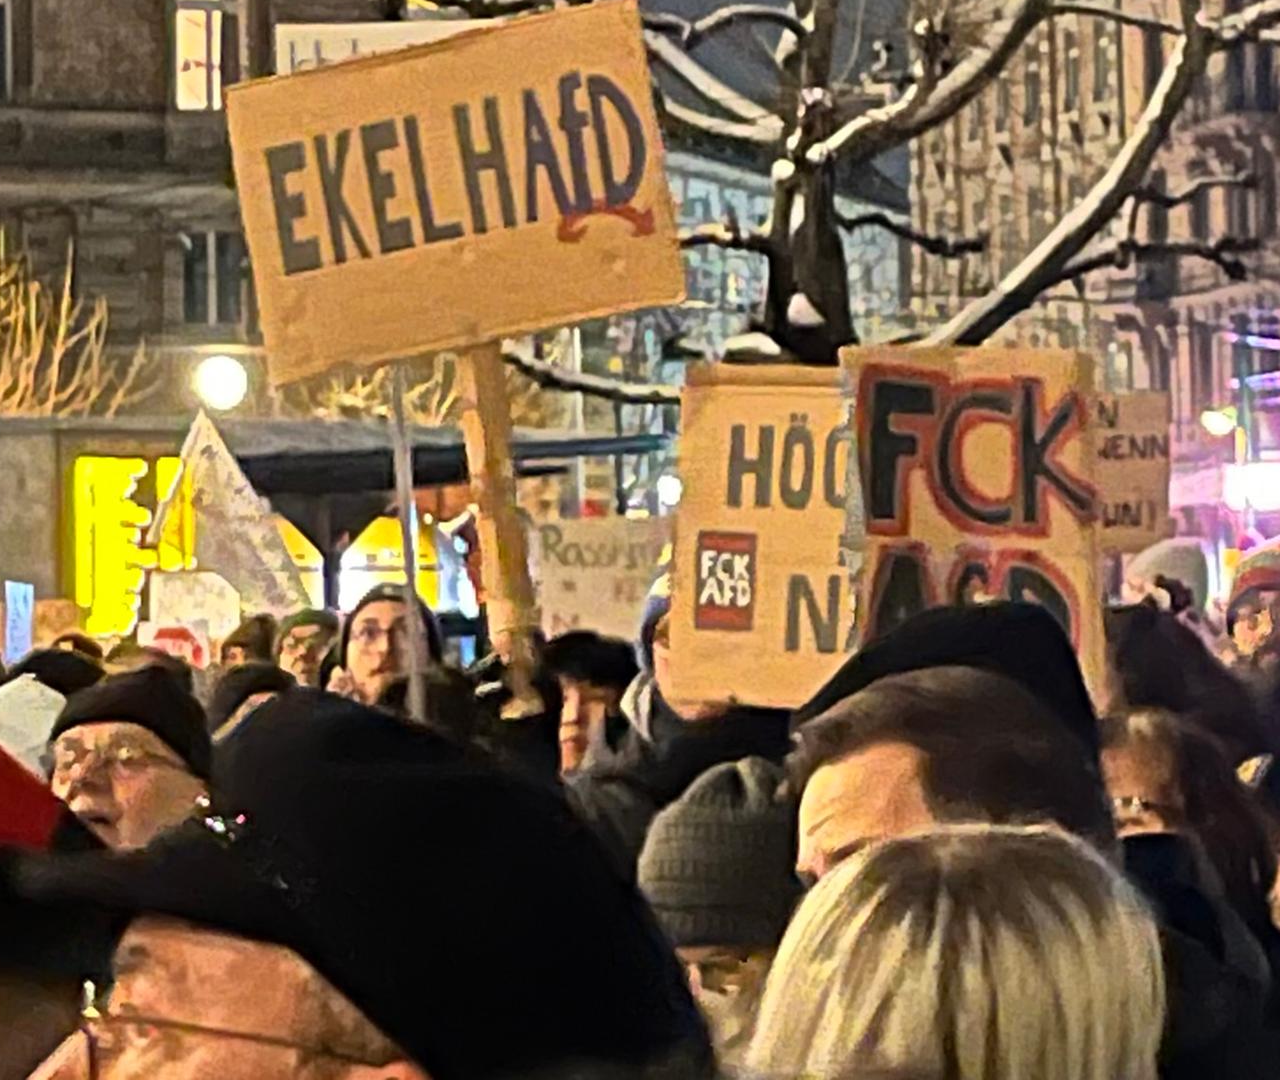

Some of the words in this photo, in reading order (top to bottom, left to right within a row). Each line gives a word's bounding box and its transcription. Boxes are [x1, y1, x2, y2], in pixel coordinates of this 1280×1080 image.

[860, 365, 1097, 535] FCK
[700, 549, 751, 581] FCK
[699, 576, 752, 608] AFD
